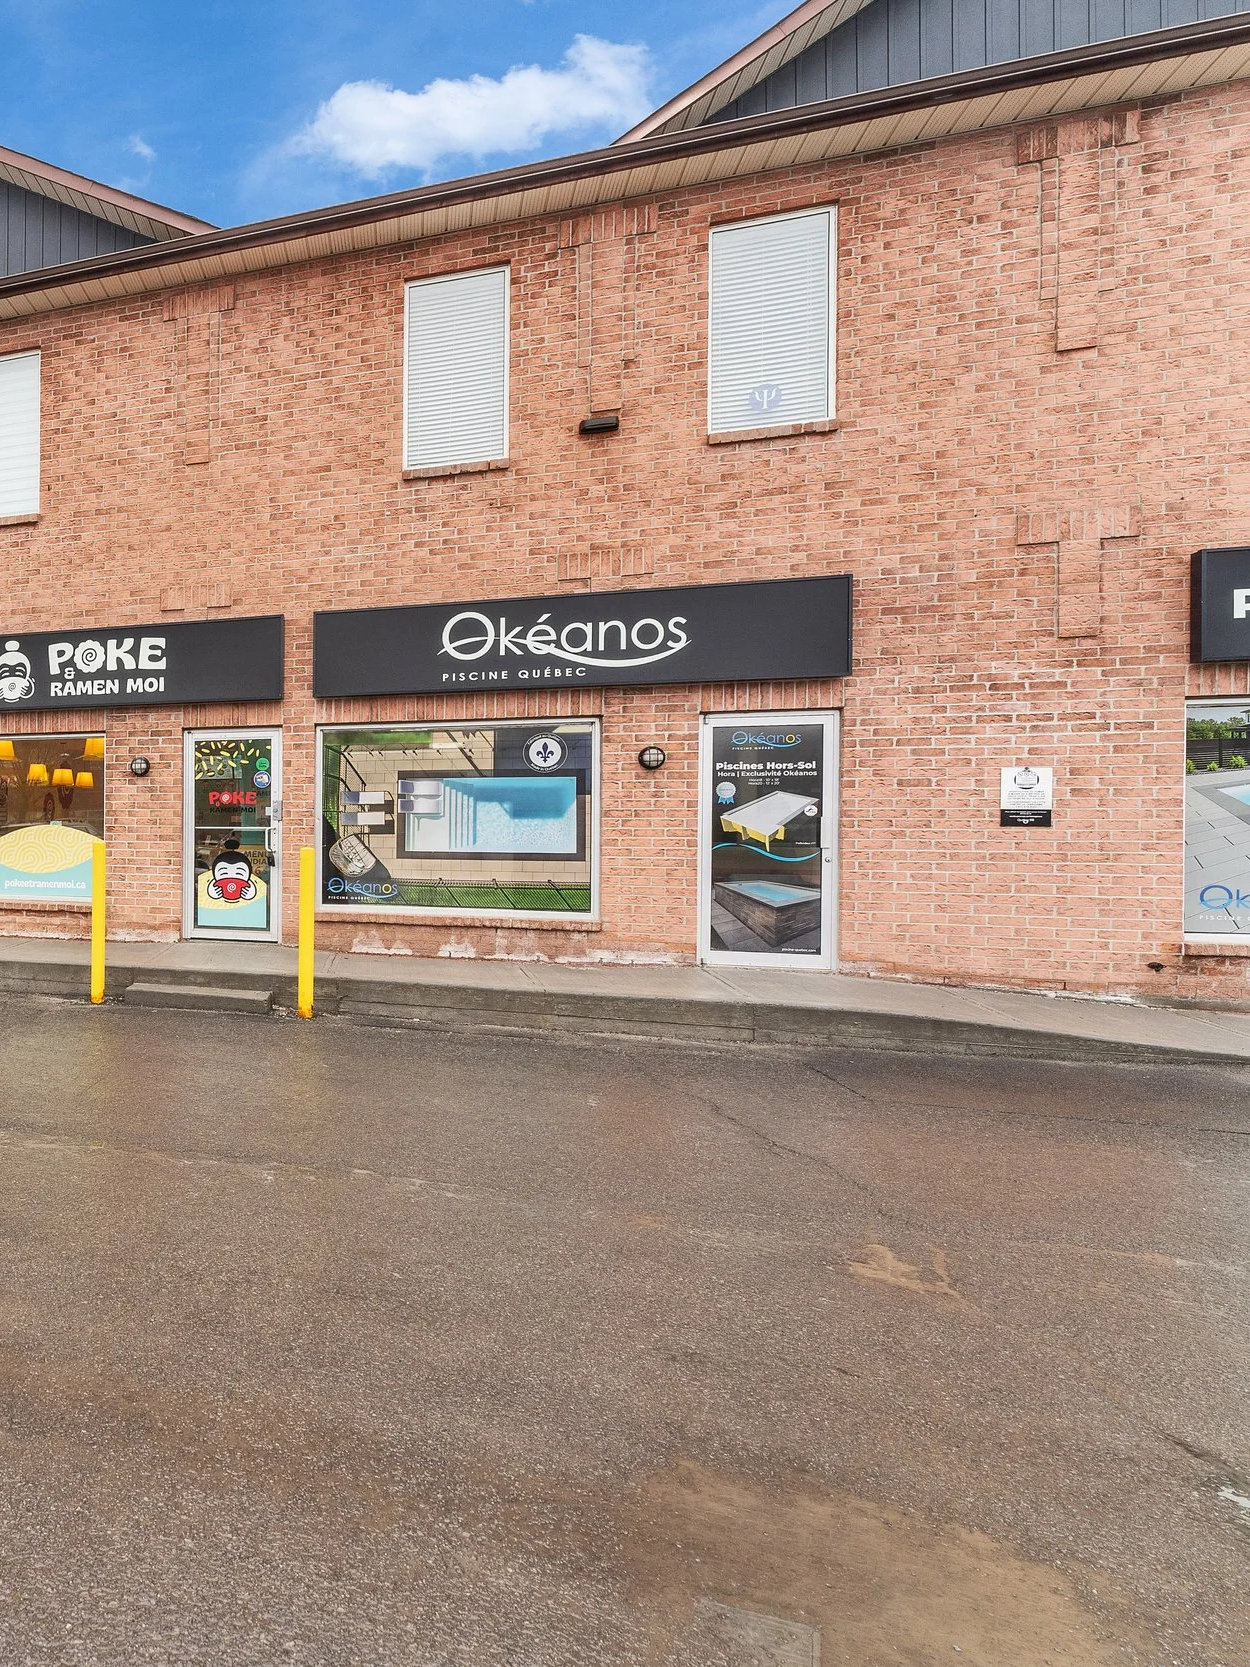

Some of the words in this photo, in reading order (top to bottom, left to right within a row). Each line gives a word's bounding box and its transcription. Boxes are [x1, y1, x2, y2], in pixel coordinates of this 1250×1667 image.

[438, 612, 691, 667] Okéanos
[48, 637, 167, 675] POKE
[64, 667, 76, 679] &
[442, 670, 508, 682] PISCINE
[518, 666, 587, 679] QUÉBEC
[50, 679, 119, 697] RAMEN
[126, 677, 165, 694] MOI
[732, 731, 802, 747] Okéanos
[716, 761, 764, 770] Piscines
[766, 761, 816, 770] Hors-Sol
[741, 769, 782, 777] Exclusivité
[208, 791, 257, 805] POKE
[4, 878, 86, 889] pokeetramenmoi.ca
[327, 877, 398, 898] Okéanos
